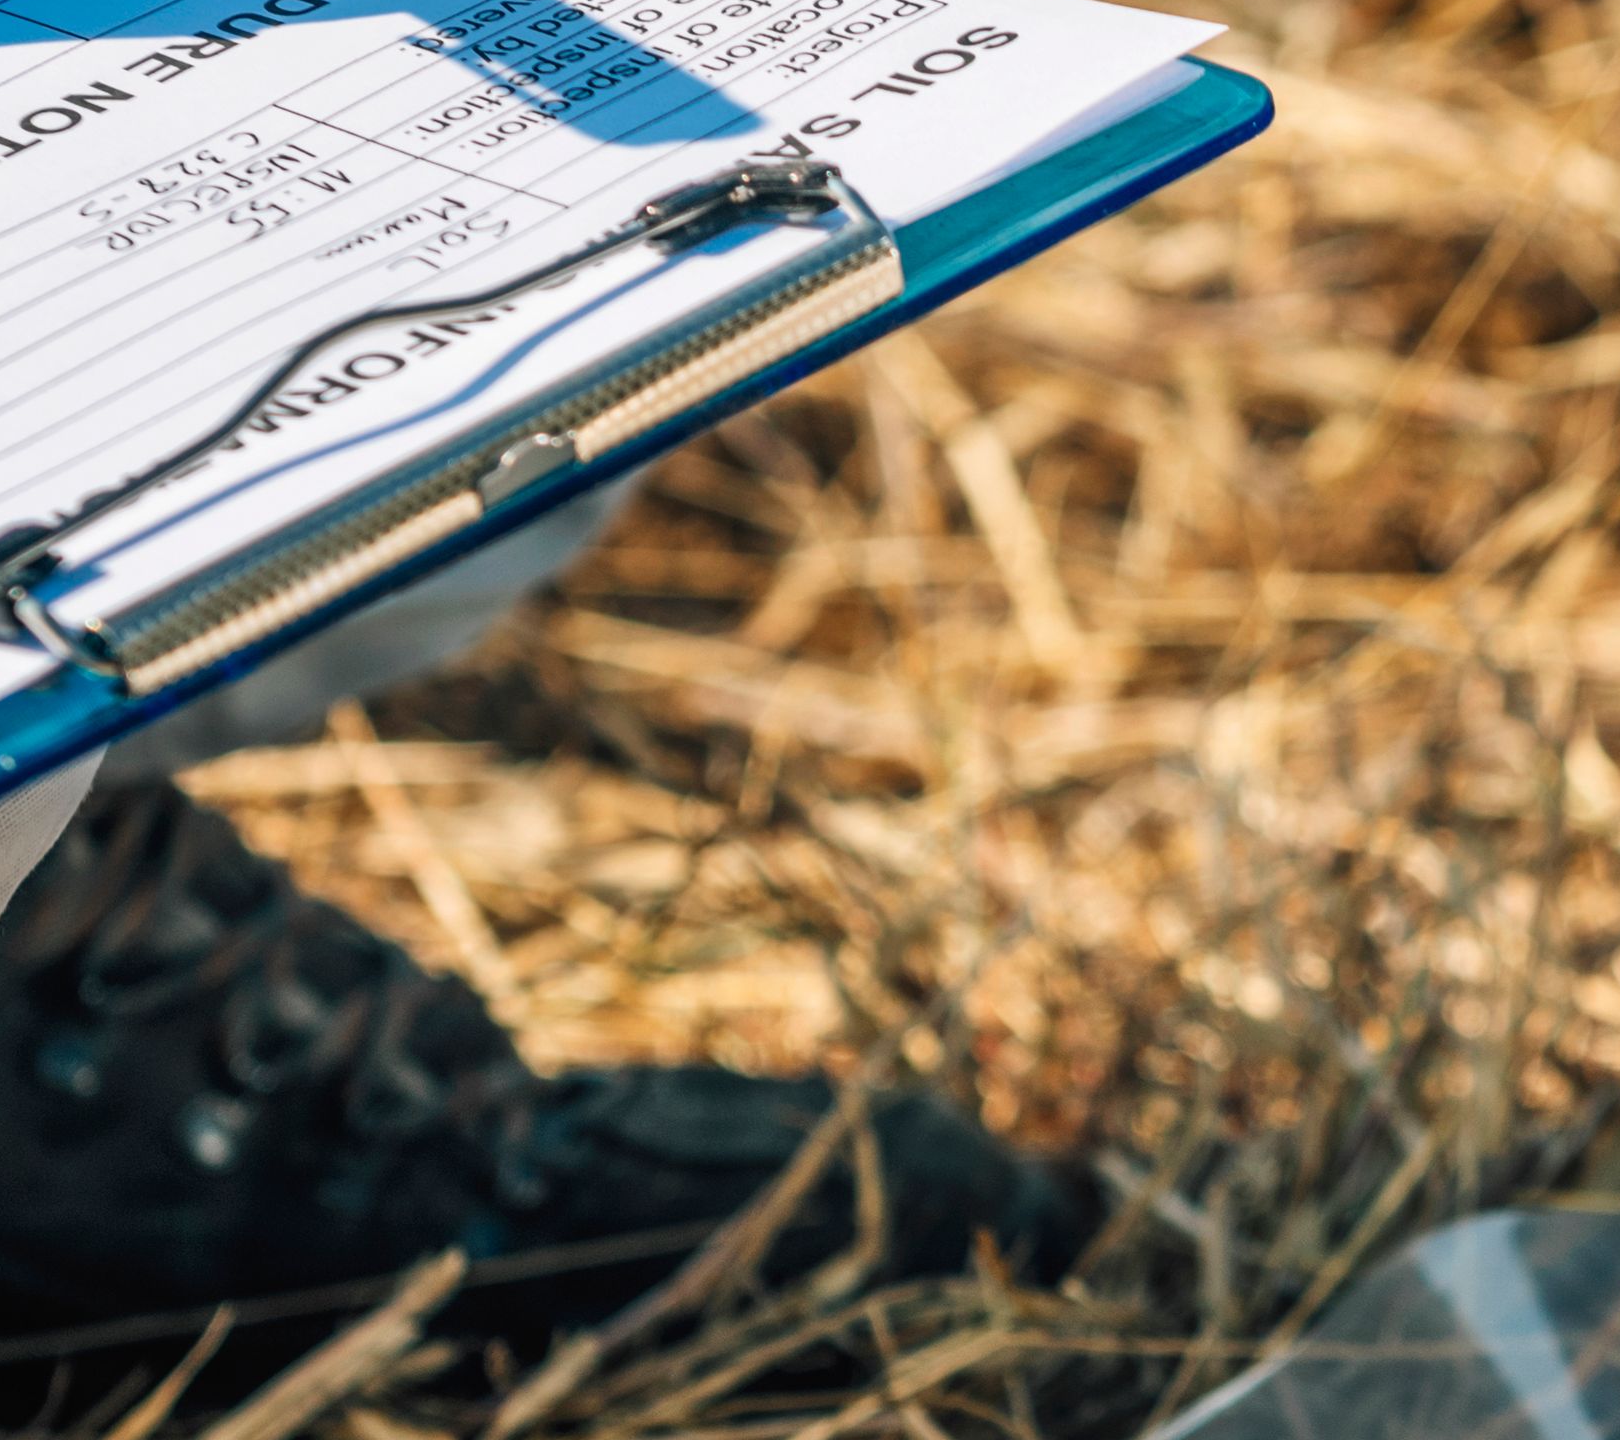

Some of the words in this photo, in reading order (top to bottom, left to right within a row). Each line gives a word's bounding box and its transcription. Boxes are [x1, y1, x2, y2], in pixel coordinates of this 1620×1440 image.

[459, 14, 520, 66] by:
[618, 5, 662, 36] of
[675, 18, 717, 56] of
[402, 25, 624, 140] inspection:
[850, 25, 1017, 104] SOIL
[457, 44, 681, 153] inspection:
